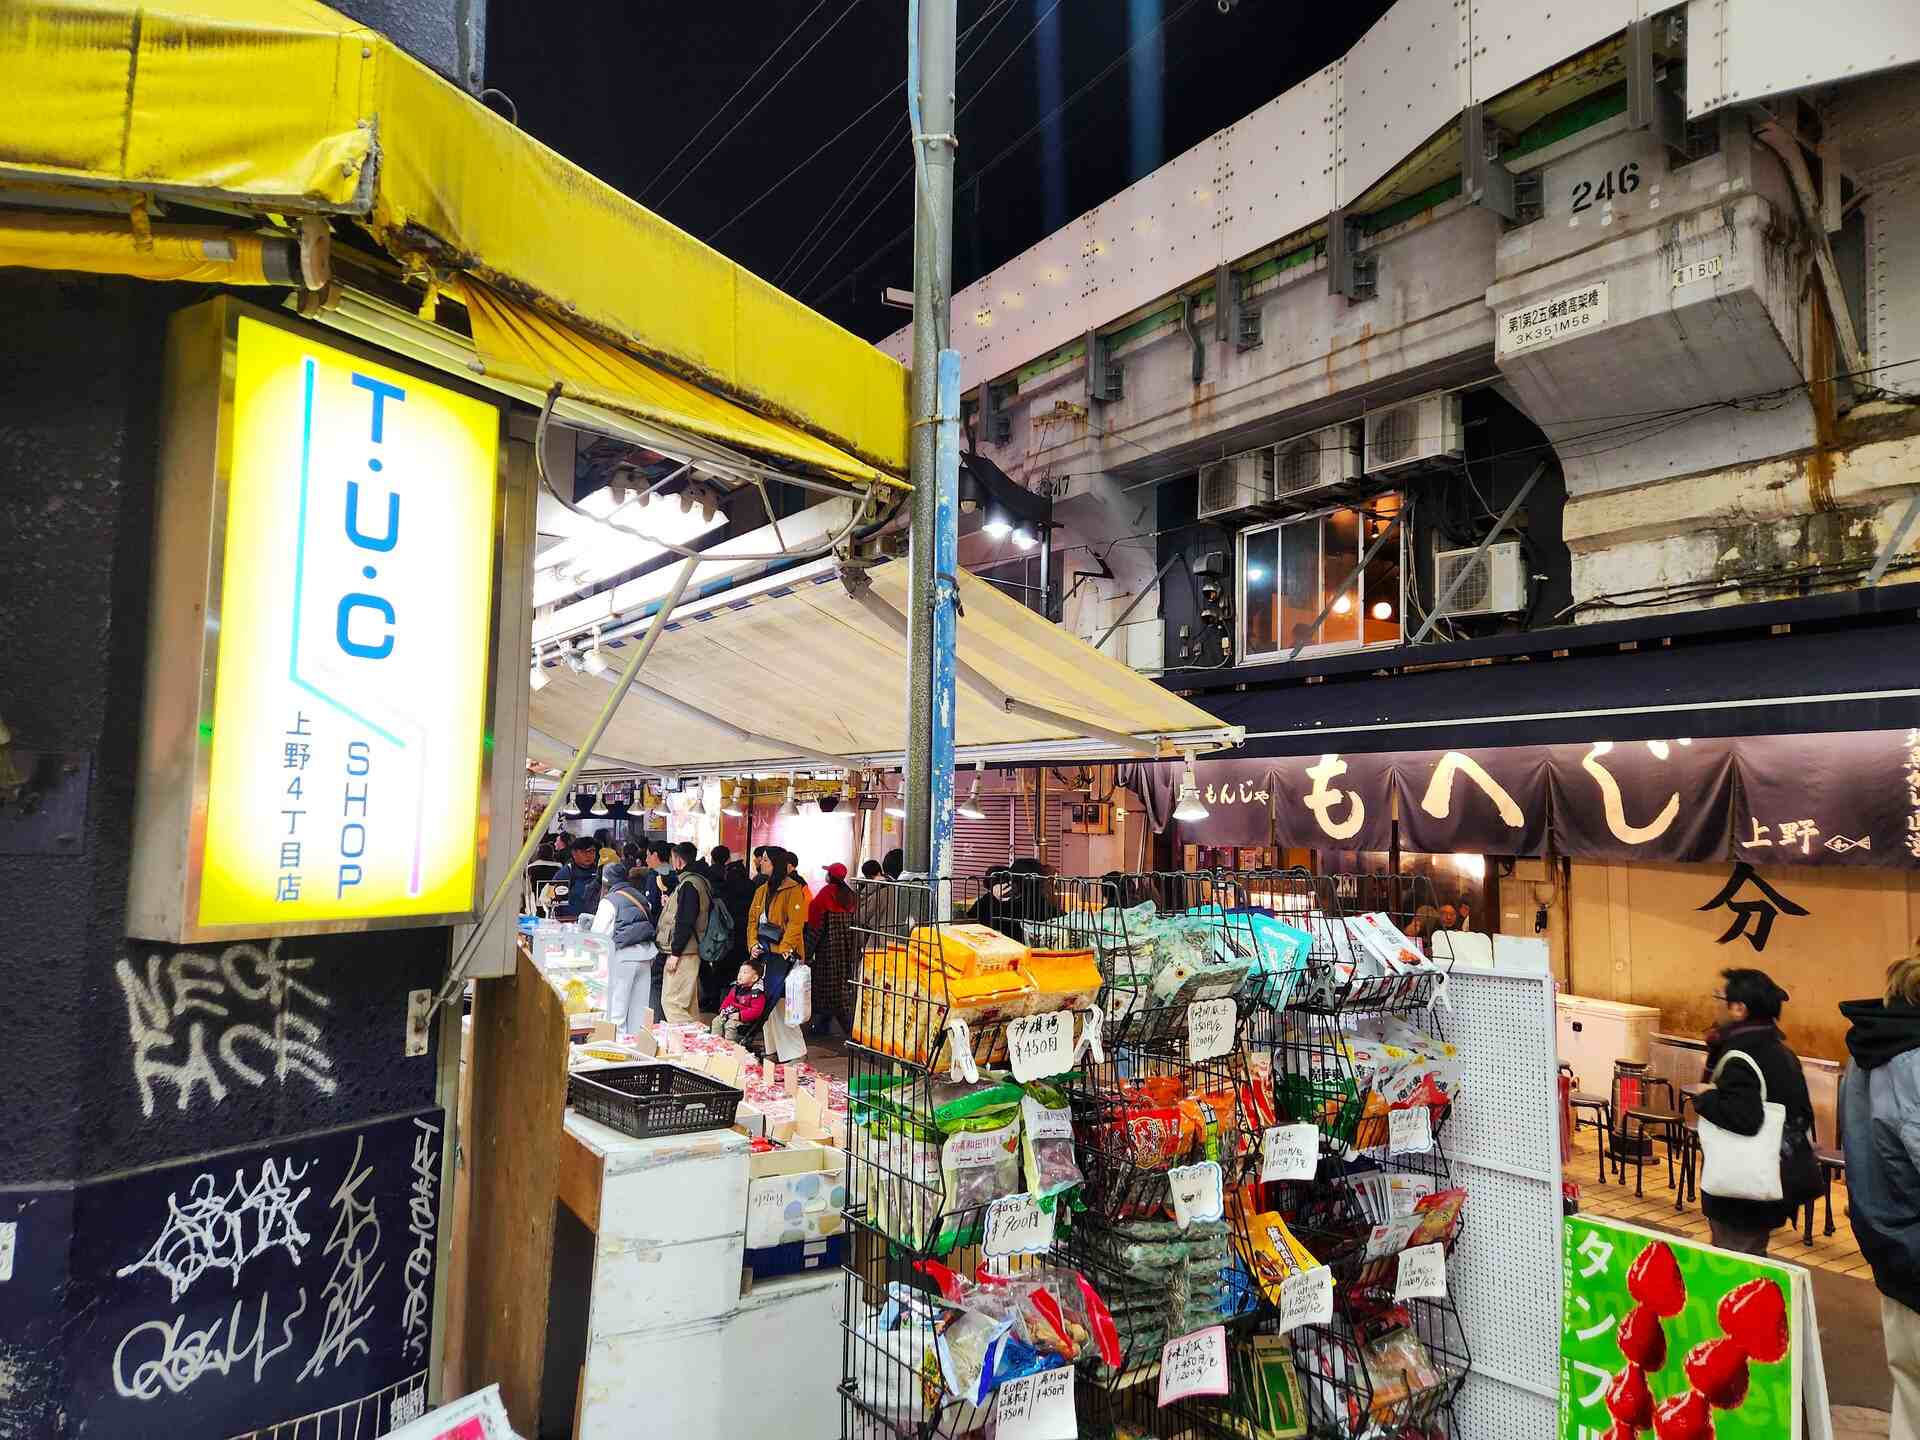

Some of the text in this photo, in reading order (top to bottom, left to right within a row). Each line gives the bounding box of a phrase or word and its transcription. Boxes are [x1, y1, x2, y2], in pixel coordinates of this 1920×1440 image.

[1571, 162, 1641, 214] 246
[276, 711, 312, 903] 上野4丁目店
[337, 741, 371, 900] SHOP
[1742, 817, 1820, 857] 上野
[1696, 860, 1811, 952] 分
